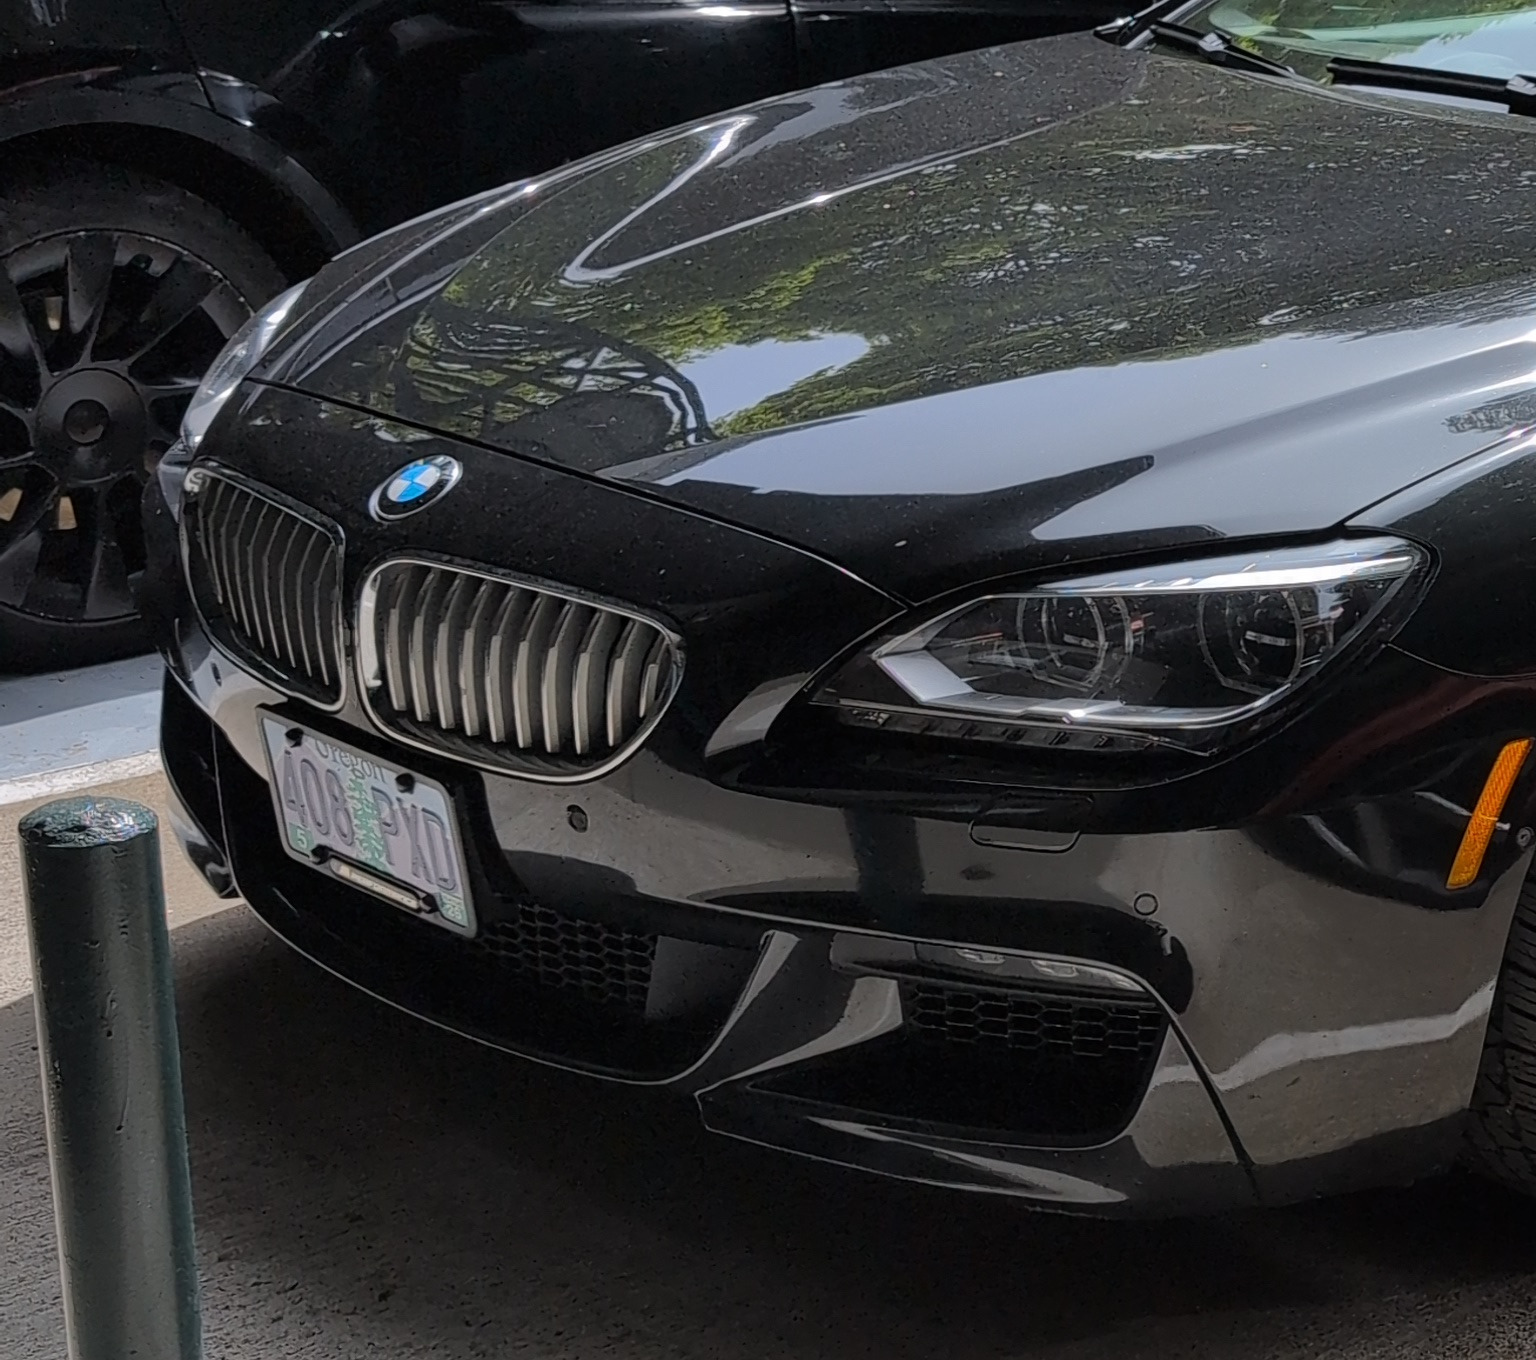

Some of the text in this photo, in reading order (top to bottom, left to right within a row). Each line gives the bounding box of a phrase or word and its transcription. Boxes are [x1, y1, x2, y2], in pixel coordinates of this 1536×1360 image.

[283, 749, 457, 891] 408 PXD
[296, 828, 308, 849] 5
